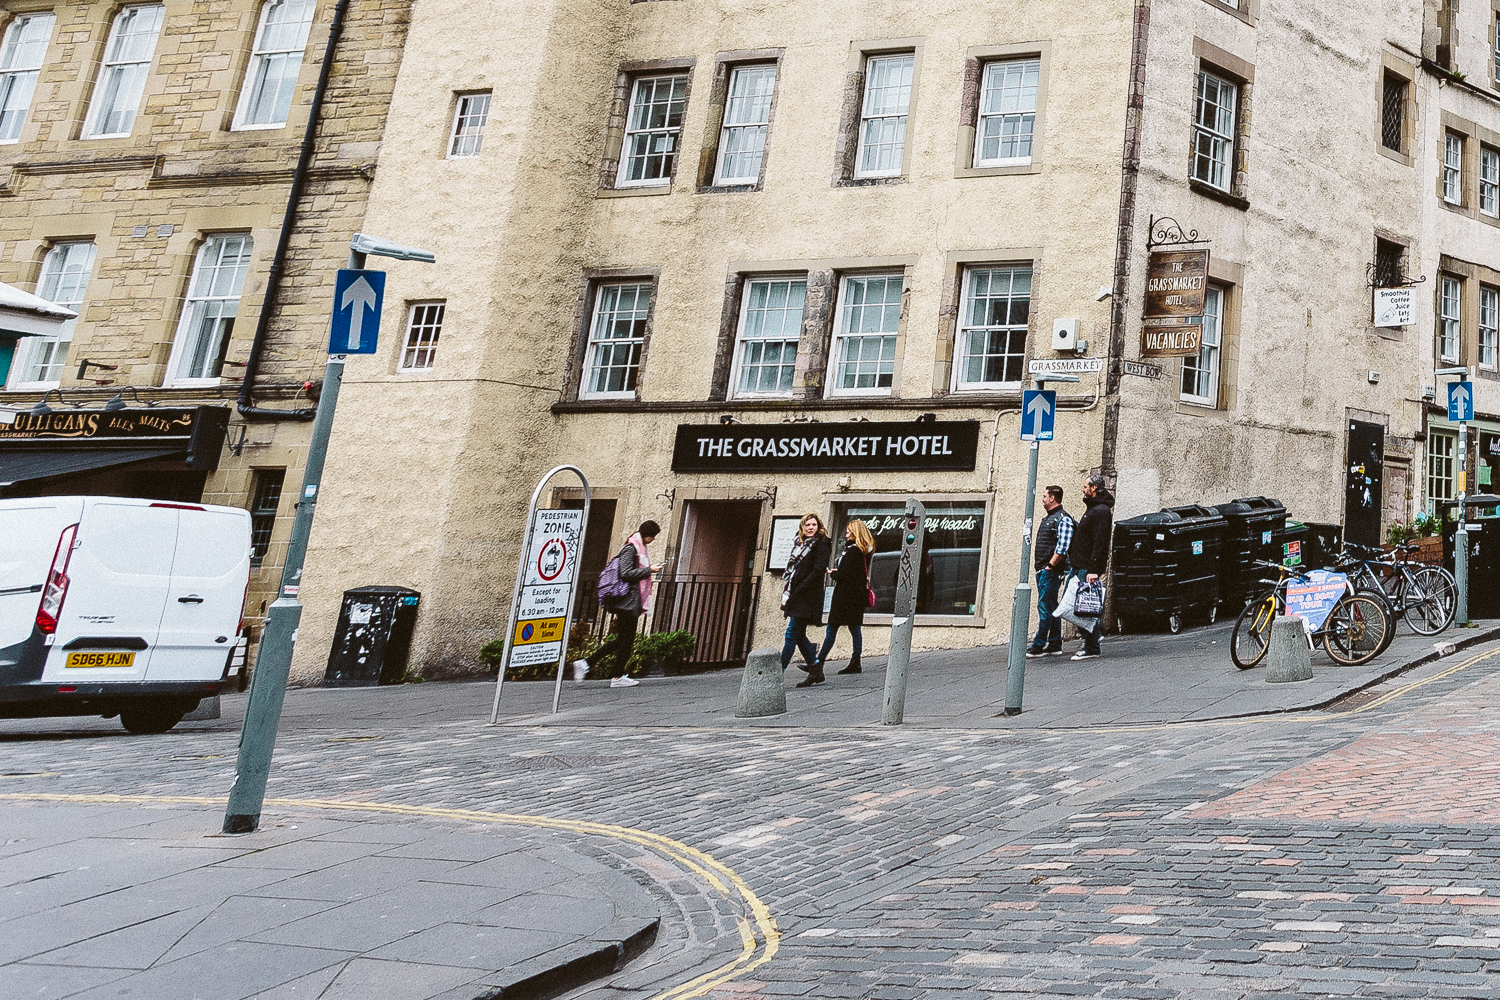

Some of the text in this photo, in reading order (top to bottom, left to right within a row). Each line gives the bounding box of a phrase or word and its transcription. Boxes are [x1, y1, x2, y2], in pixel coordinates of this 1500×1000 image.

[1172, 262, 1183, 273] THE
[1148, 276, 1204, 292] GRASSMARKET
[1165, 295, 1182, 306] HOTEL
[1146, 332, 1196, 349] VACANCIES
[1031, 361, 1100, 371] GRASSMARKET
[1127, 363, 1160, 377] WEST BOW
[109, 417, 135, 432] ALES
[139, 415, 172, 432] MALTS
[697, 436, 952, 457] THE GRASSMARKET HOTEL
[541, 512, 578, 520] PEDESTRIAN
[543, 522, 571, 533] ZONE
[940, 516, 976, 530] heads
[532, 588, 552, 596] Except
[1287, 595, 1304, 603] BUS
[1314, 591, 1336, 600] BOAT
[1300, 601, 1323, 609] TOUR
[542, 630, 554, 638] time
[72, 653, 131, 665] SD66 HJN
